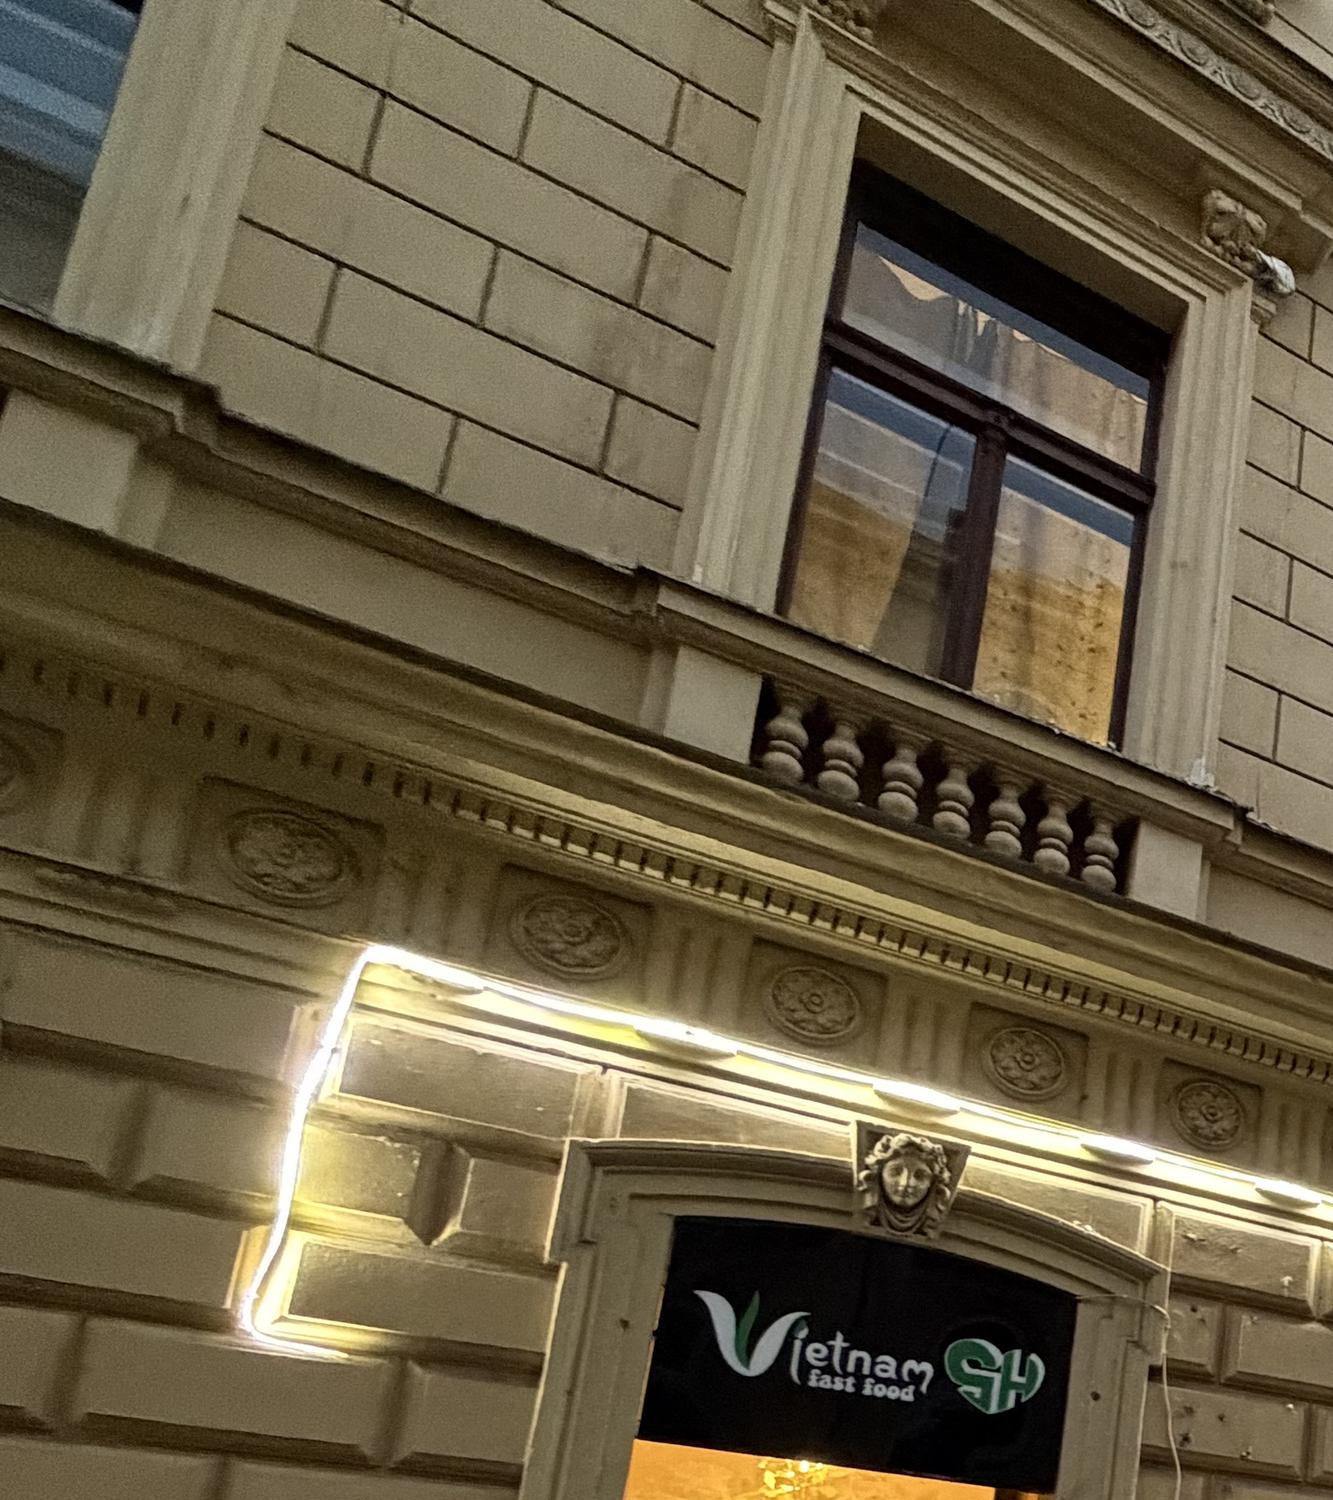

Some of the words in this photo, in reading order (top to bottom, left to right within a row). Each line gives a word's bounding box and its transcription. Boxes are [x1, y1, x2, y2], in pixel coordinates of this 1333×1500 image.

[694, 1290, 933, 1394] Vietnam
[807, 1369, 856, 1392] fast
[863, 1379, 917, 1402] food
